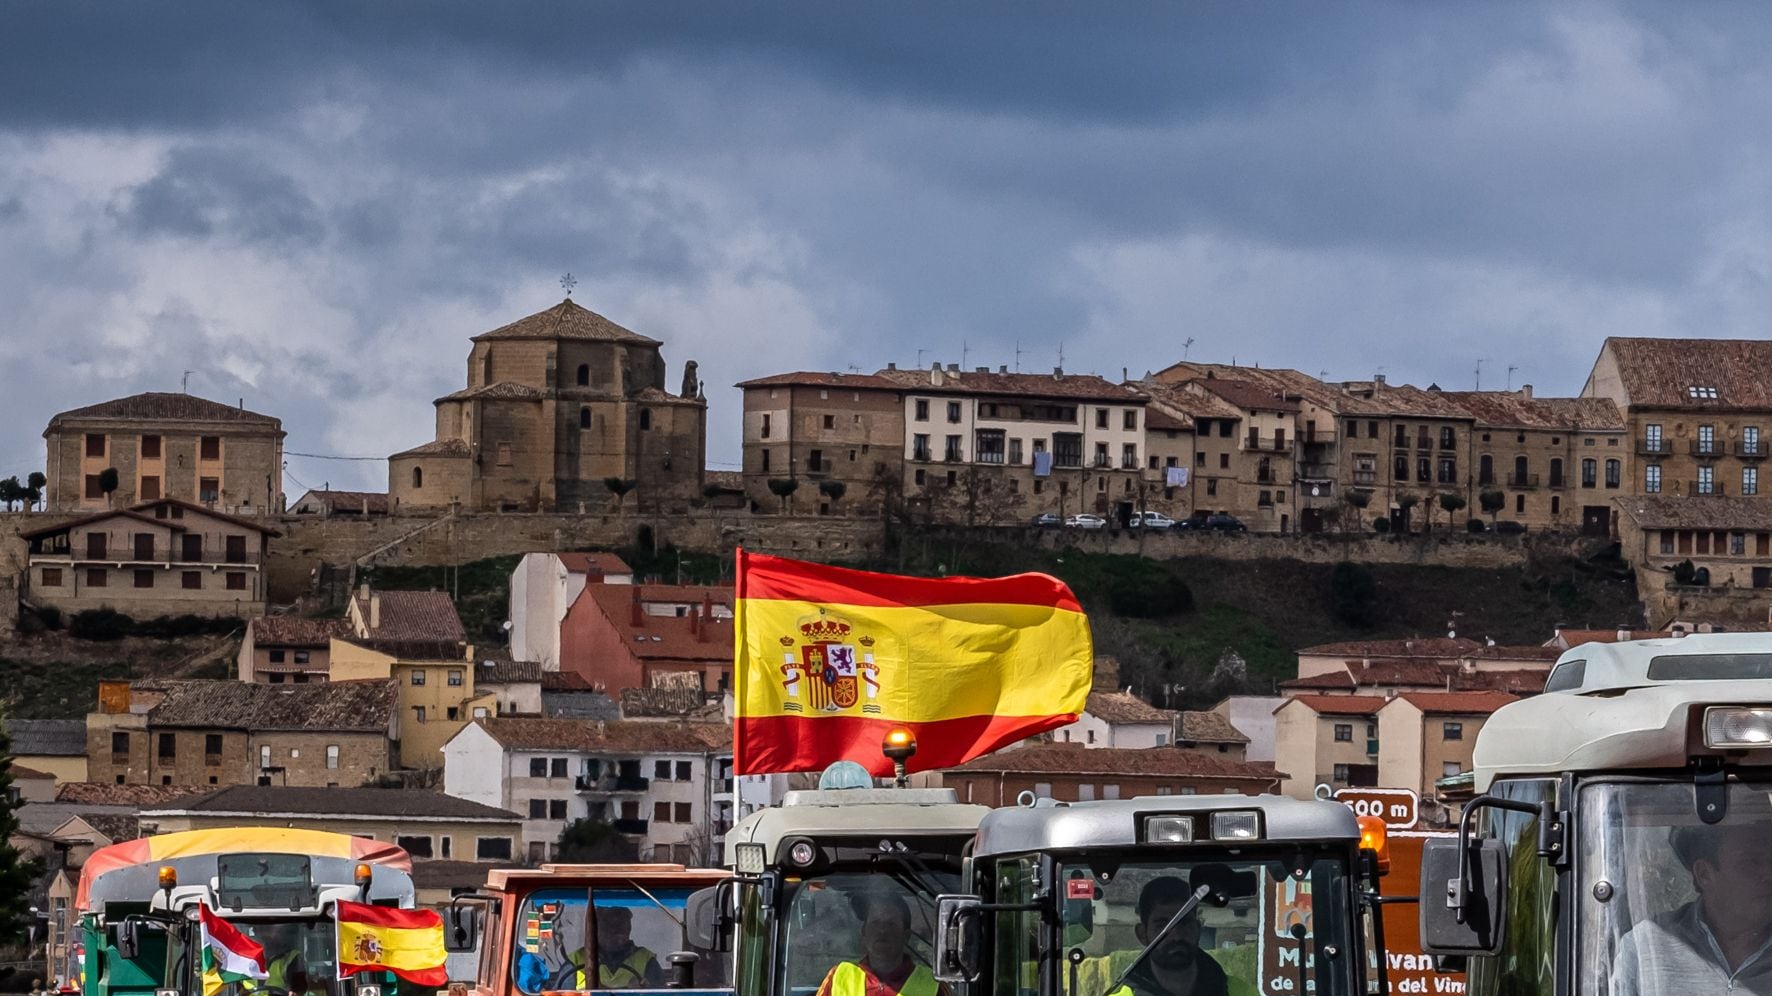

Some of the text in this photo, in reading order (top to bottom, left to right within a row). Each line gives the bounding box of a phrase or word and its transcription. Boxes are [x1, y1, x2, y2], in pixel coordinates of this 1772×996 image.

[1390, 804, 1408, 817] m
[1270, 976, 1294, 991] de
[1398, 977, 1428, 993] del
